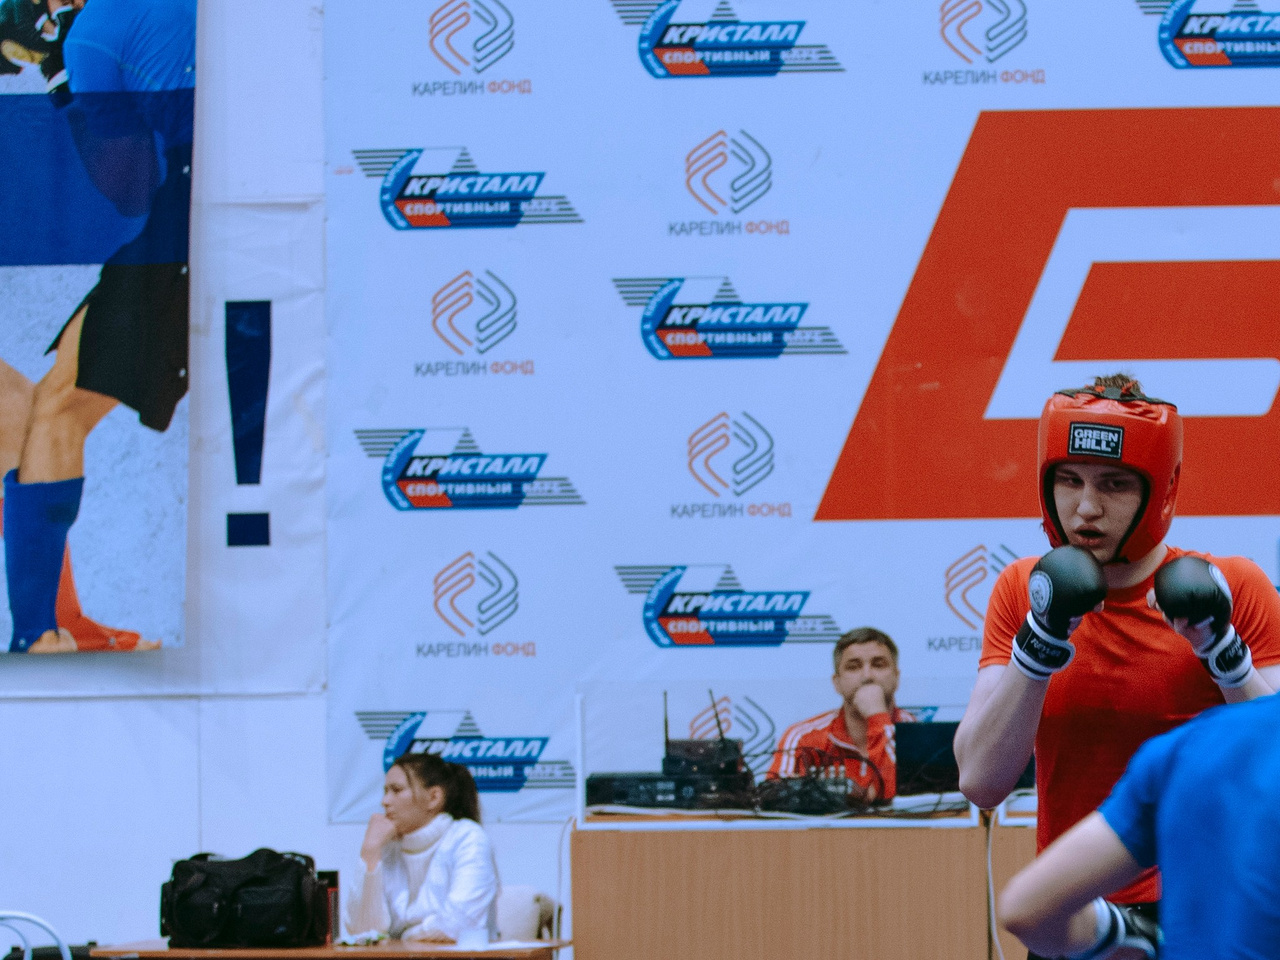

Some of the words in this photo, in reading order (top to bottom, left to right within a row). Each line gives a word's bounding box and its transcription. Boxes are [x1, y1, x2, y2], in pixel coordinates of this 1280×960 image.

[663, 24, 797, 45] КРИСТАЛЛ
[663, 49, 769, 65] СПОРТИВНЫЙ
[923, 69, 997, 85] КАРЕЛИН
[1000, 69, 1045, 84] ФОНД
[411, 80, 485, 96] КАРЕЛИН
[488, 80, 533, 95] ФОНД
[404, 175, 538, 196] КРИСТАЛЛ
[404, 200, 510, 216] СПОРТИВНЫЙ
[668, 220, 742, 236] КАРЕЛИН
[745, 220, 790, 235] ФОНД
[666, 305, 800, 326] КРИСТАЛЛ
[666, 330, 772, 346] СПОРТИВНЫЙ
[414, 360, 488, 376] КАРЕЛИН
[491, 360, 536, 375] ФОНД
[1074, 428, 1118, 443] GREEN
[1074, 437, 1112, 453] HILL
[406, 456, 540, 477] КРИСТАЛЛ
[406, 481, 512, 497] СПОРТИВНЫЙ
[670, 502, 744, 518] КАРЕЛИН
[747, 502, 792, 517] ФОНД
[668, 593, 802, 614] КРИСТАЛЛ
[668, 618, 774, 634] СПОРТИВНЫЙ
[415, 642, 489, 658] КАРЕЛИН
[492, 642, 537, 657] ФОНД
[928, 636, 983, 652] КАРЕЛ
[410, 740, 542, 758] КРИСТАЛЛ
